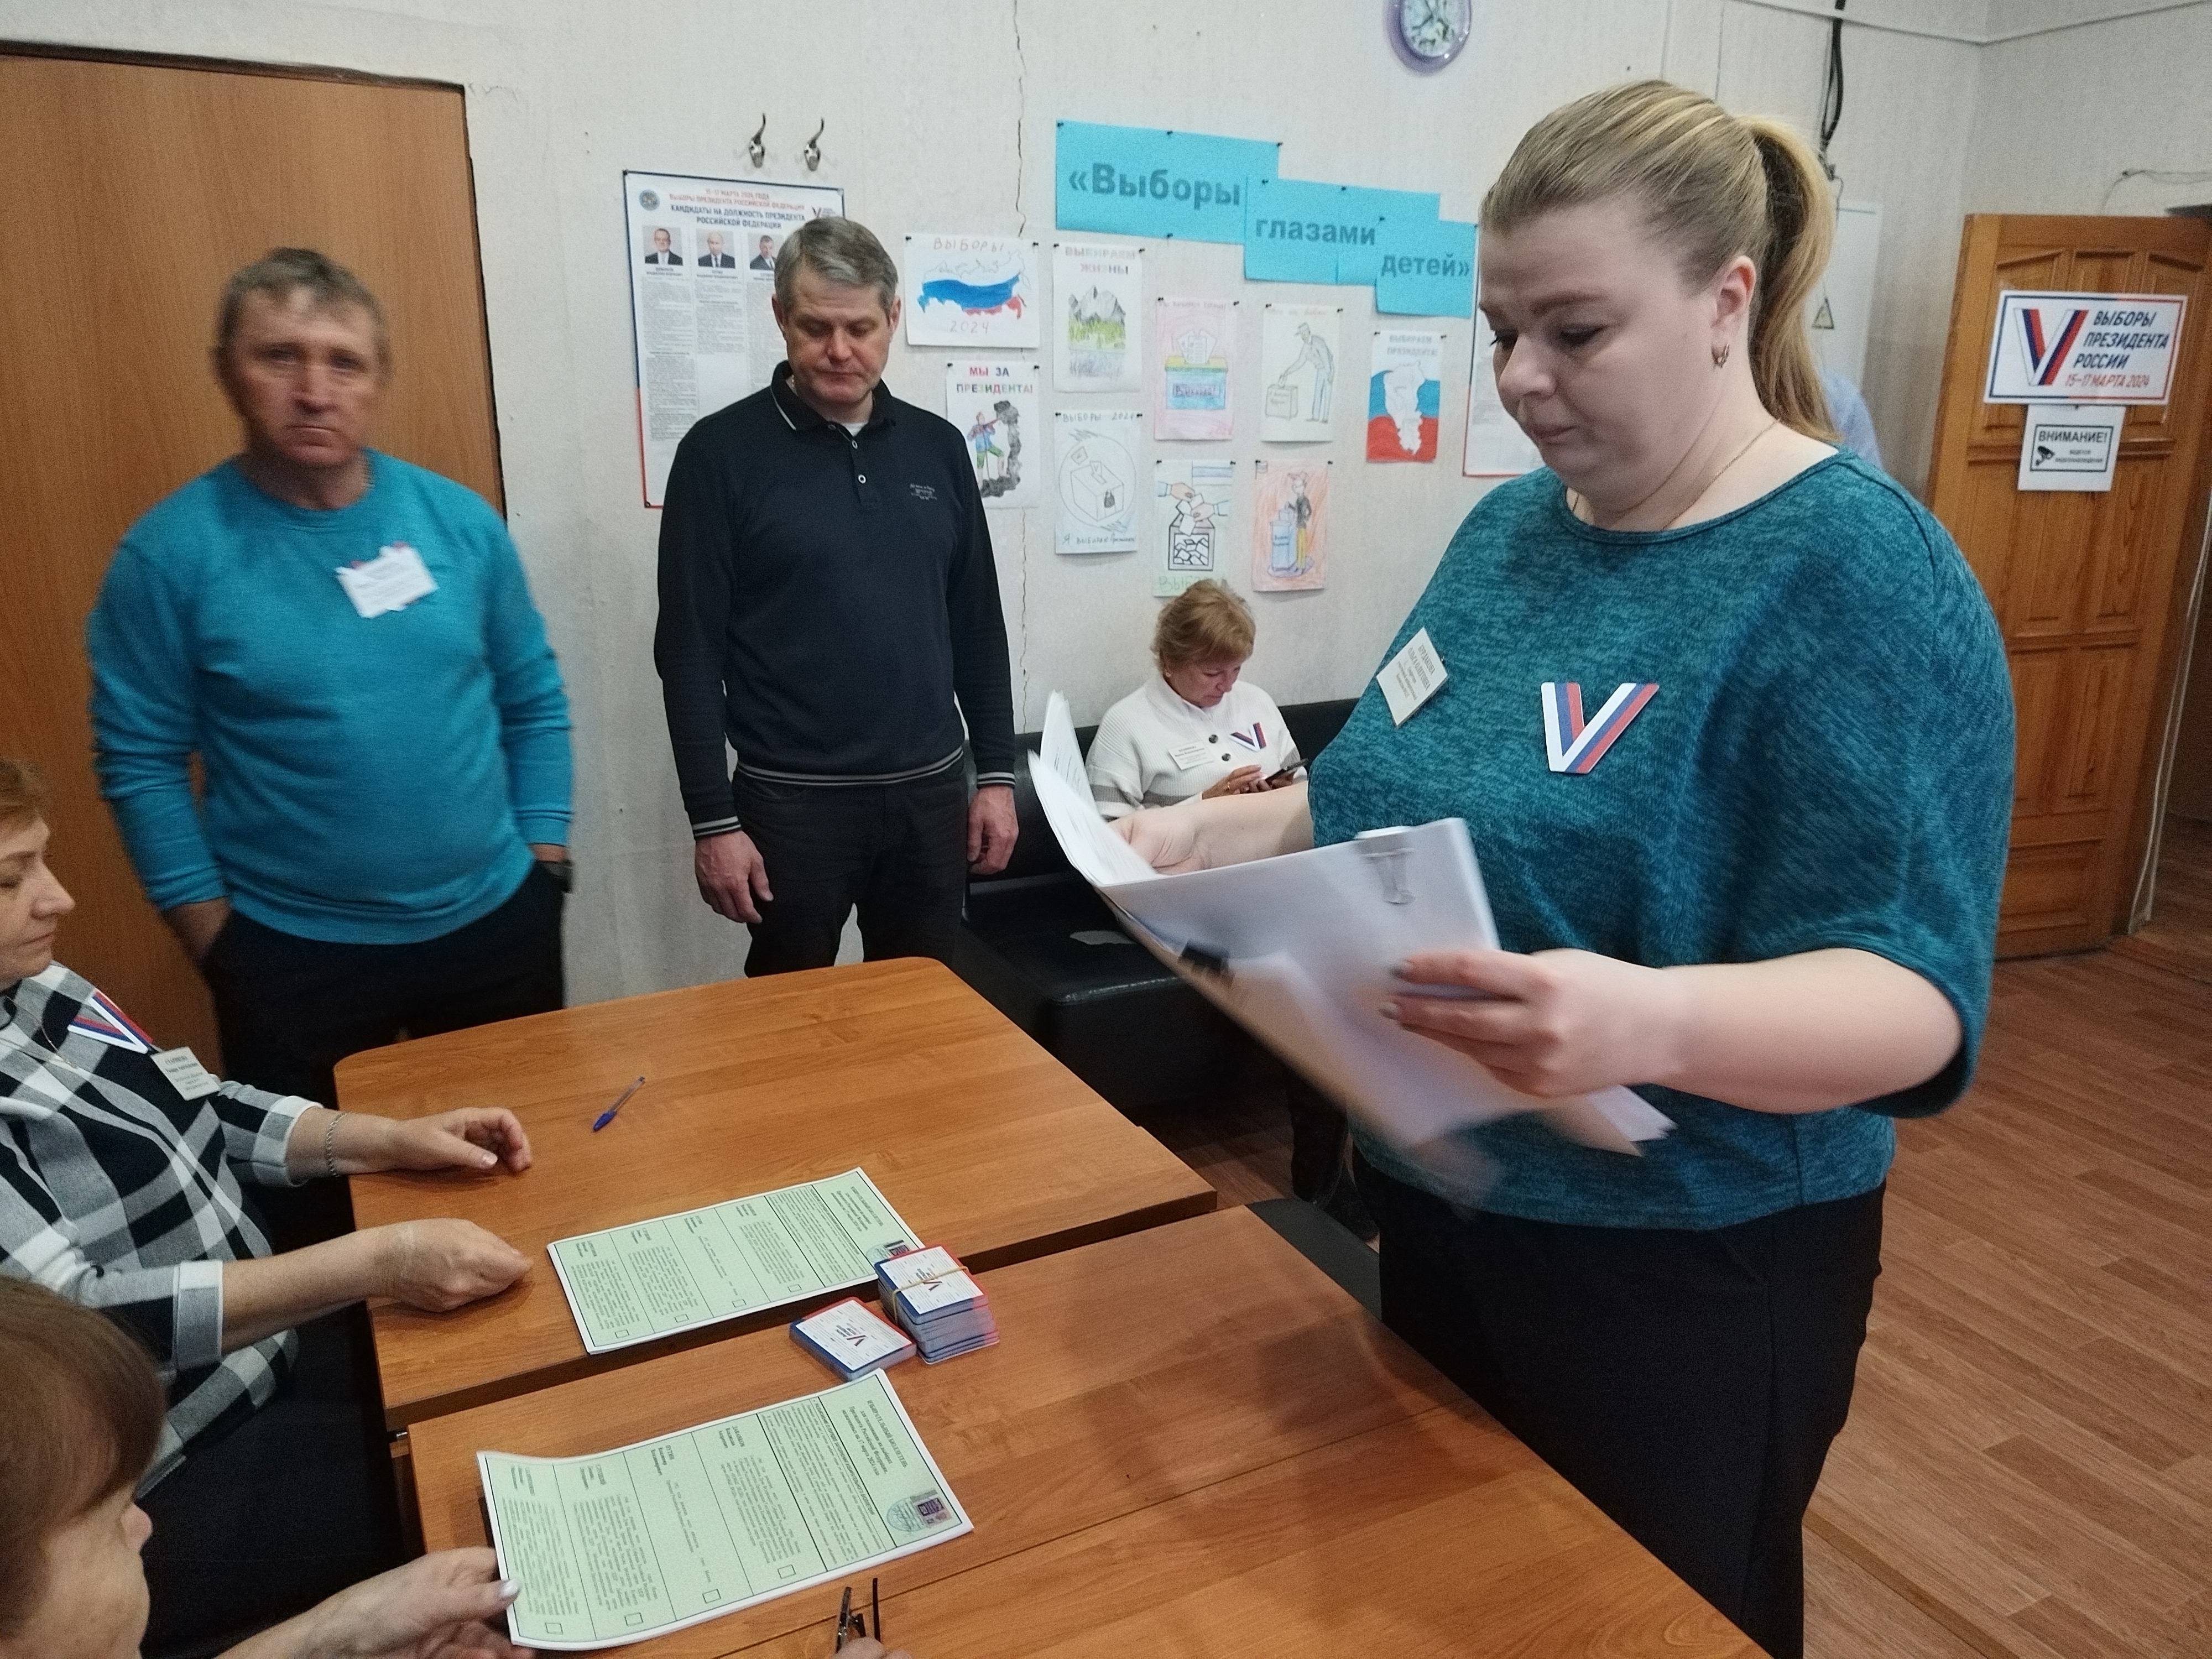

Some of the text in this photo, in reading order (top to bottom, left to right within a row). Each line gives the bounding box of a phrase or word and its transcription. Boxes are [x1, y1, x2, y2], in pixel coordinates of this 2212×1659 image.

[1068, 163, 1240, 209] «Выборы
[671, 204, 806, 222] КАНДИДАТЫ НА ДОЛЖНОСТЬ ПРЕЗИДЕНТА
[697, 216, 782, 229] РОССИЙСКОЙ ФЕДЕРАЦИИ
[1255, 218, 1375, 246] глазами
[934, 237, 1004, 252] ВЫБОРЫ
[1381, 253, 1470, 278] детей»
[2093, 311, 2157, 327] ВЫБОРЫ
[950, 321, 989, 334] 2024
[2083, 333, 2170, 350] ПРЕЗИДЕНТА
[2073, 353, 2130, 369] РОССИИ
[969, 367, 1010, 377] МЫ ЗА
[2092, 374, 2126, 387] МАРТА
[2038, 430, 2107, 443] ВНИМАНИЕ!
